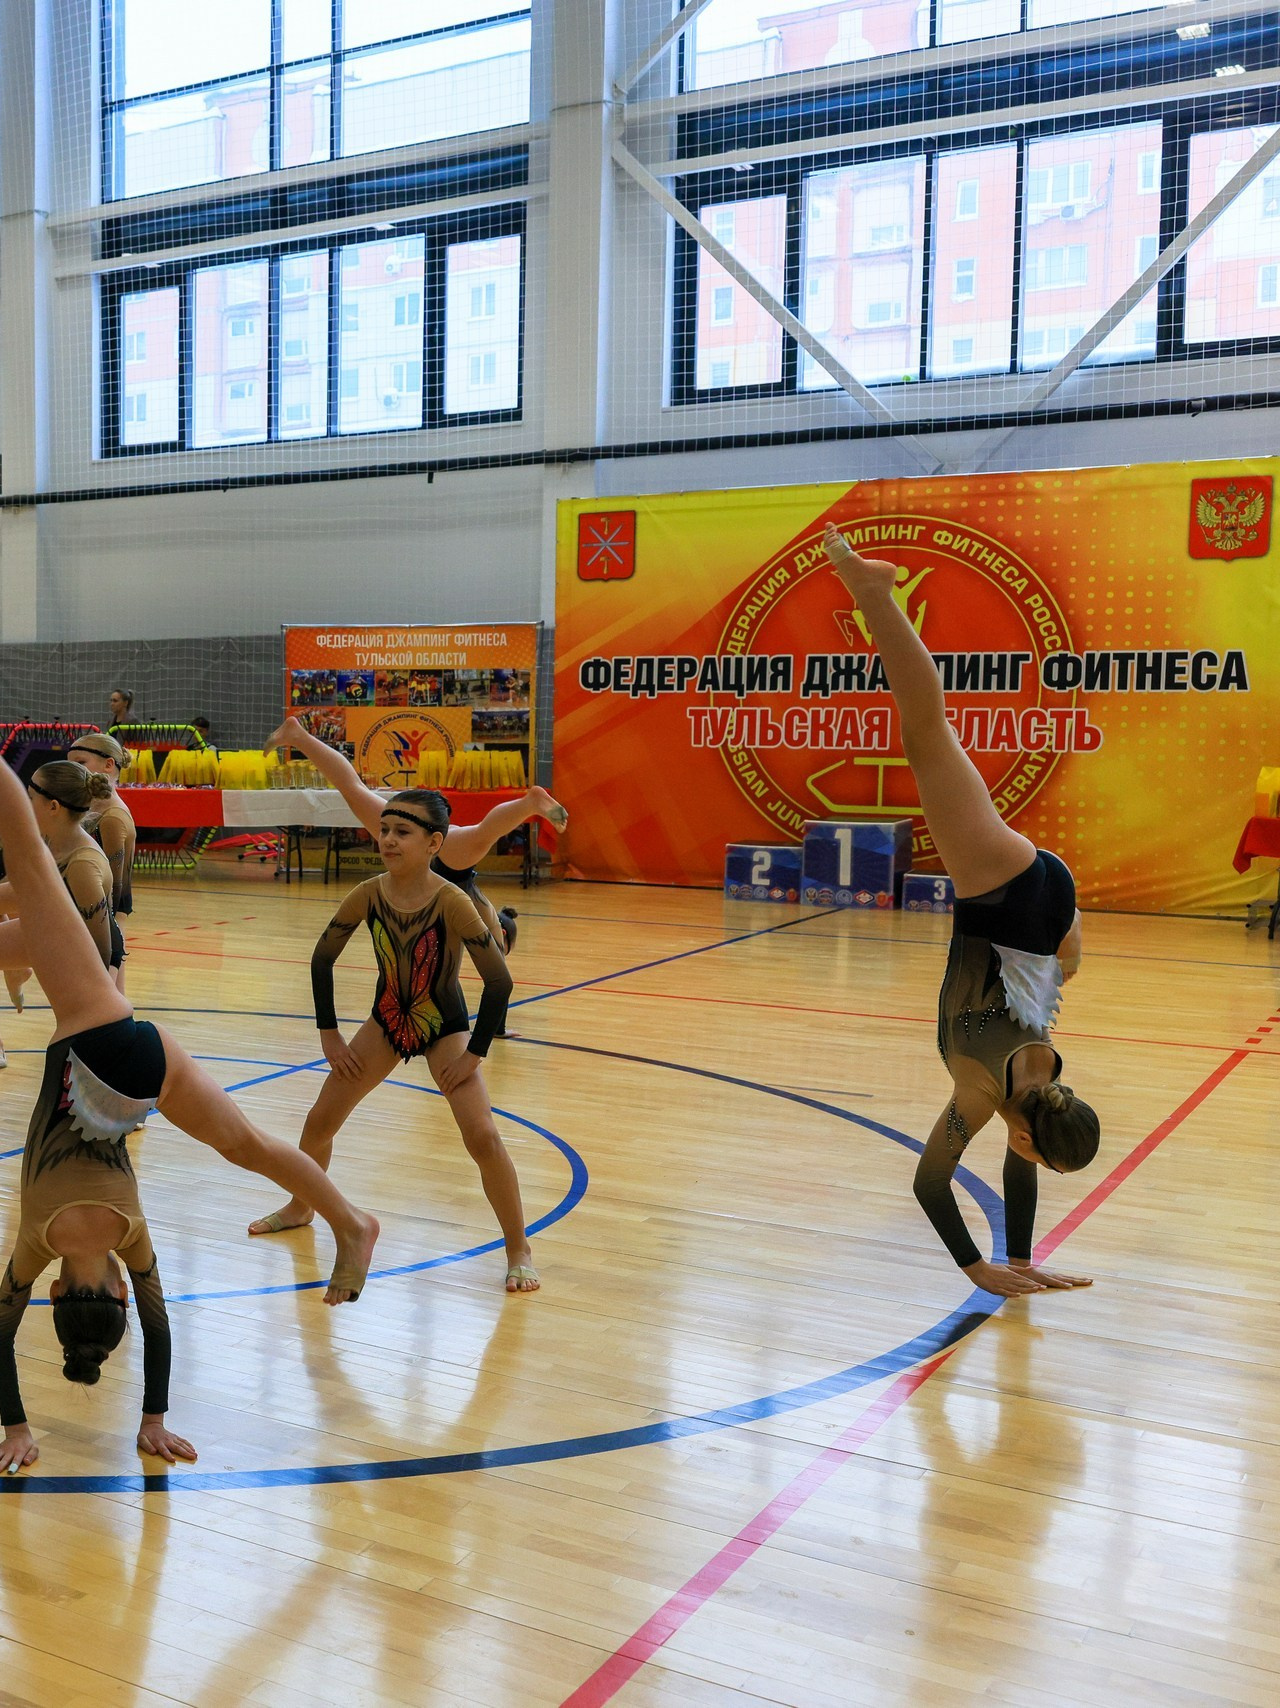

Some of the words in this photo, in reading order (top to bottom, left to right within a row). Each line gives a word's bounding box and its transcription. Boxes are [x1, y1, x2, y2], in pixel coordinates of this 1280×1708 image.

[793, 524, 926, 574] ДЖМПИНГ
[932, 529, 1029, 595] ФИТНЕСА
[316, 633, 383, 649] ФЕДЕРАЦИЯ
[385, 632, 452, 648] ДЖАМПИНГ
[454, 632, 508, 647] ФИТНЕСА
[355, 651, 413, 666] ТУЛЬСКОЙ
[416, 652, 467, 666] ОБЛАСТИ
[579, 654, 794, 699] ФЕДЕРАЦИЯ
[800, 652, 1033, 699] ДЖАПИНГ
[1041, 650, 1250, 692] ФИТНЕСА
[687, 706, 892, 751] ТУЛЬСКАЯ
[751, 851, 771, 886] 2
[834, 828, 852, 886] 1
[933, 880, 946, 900] 3
